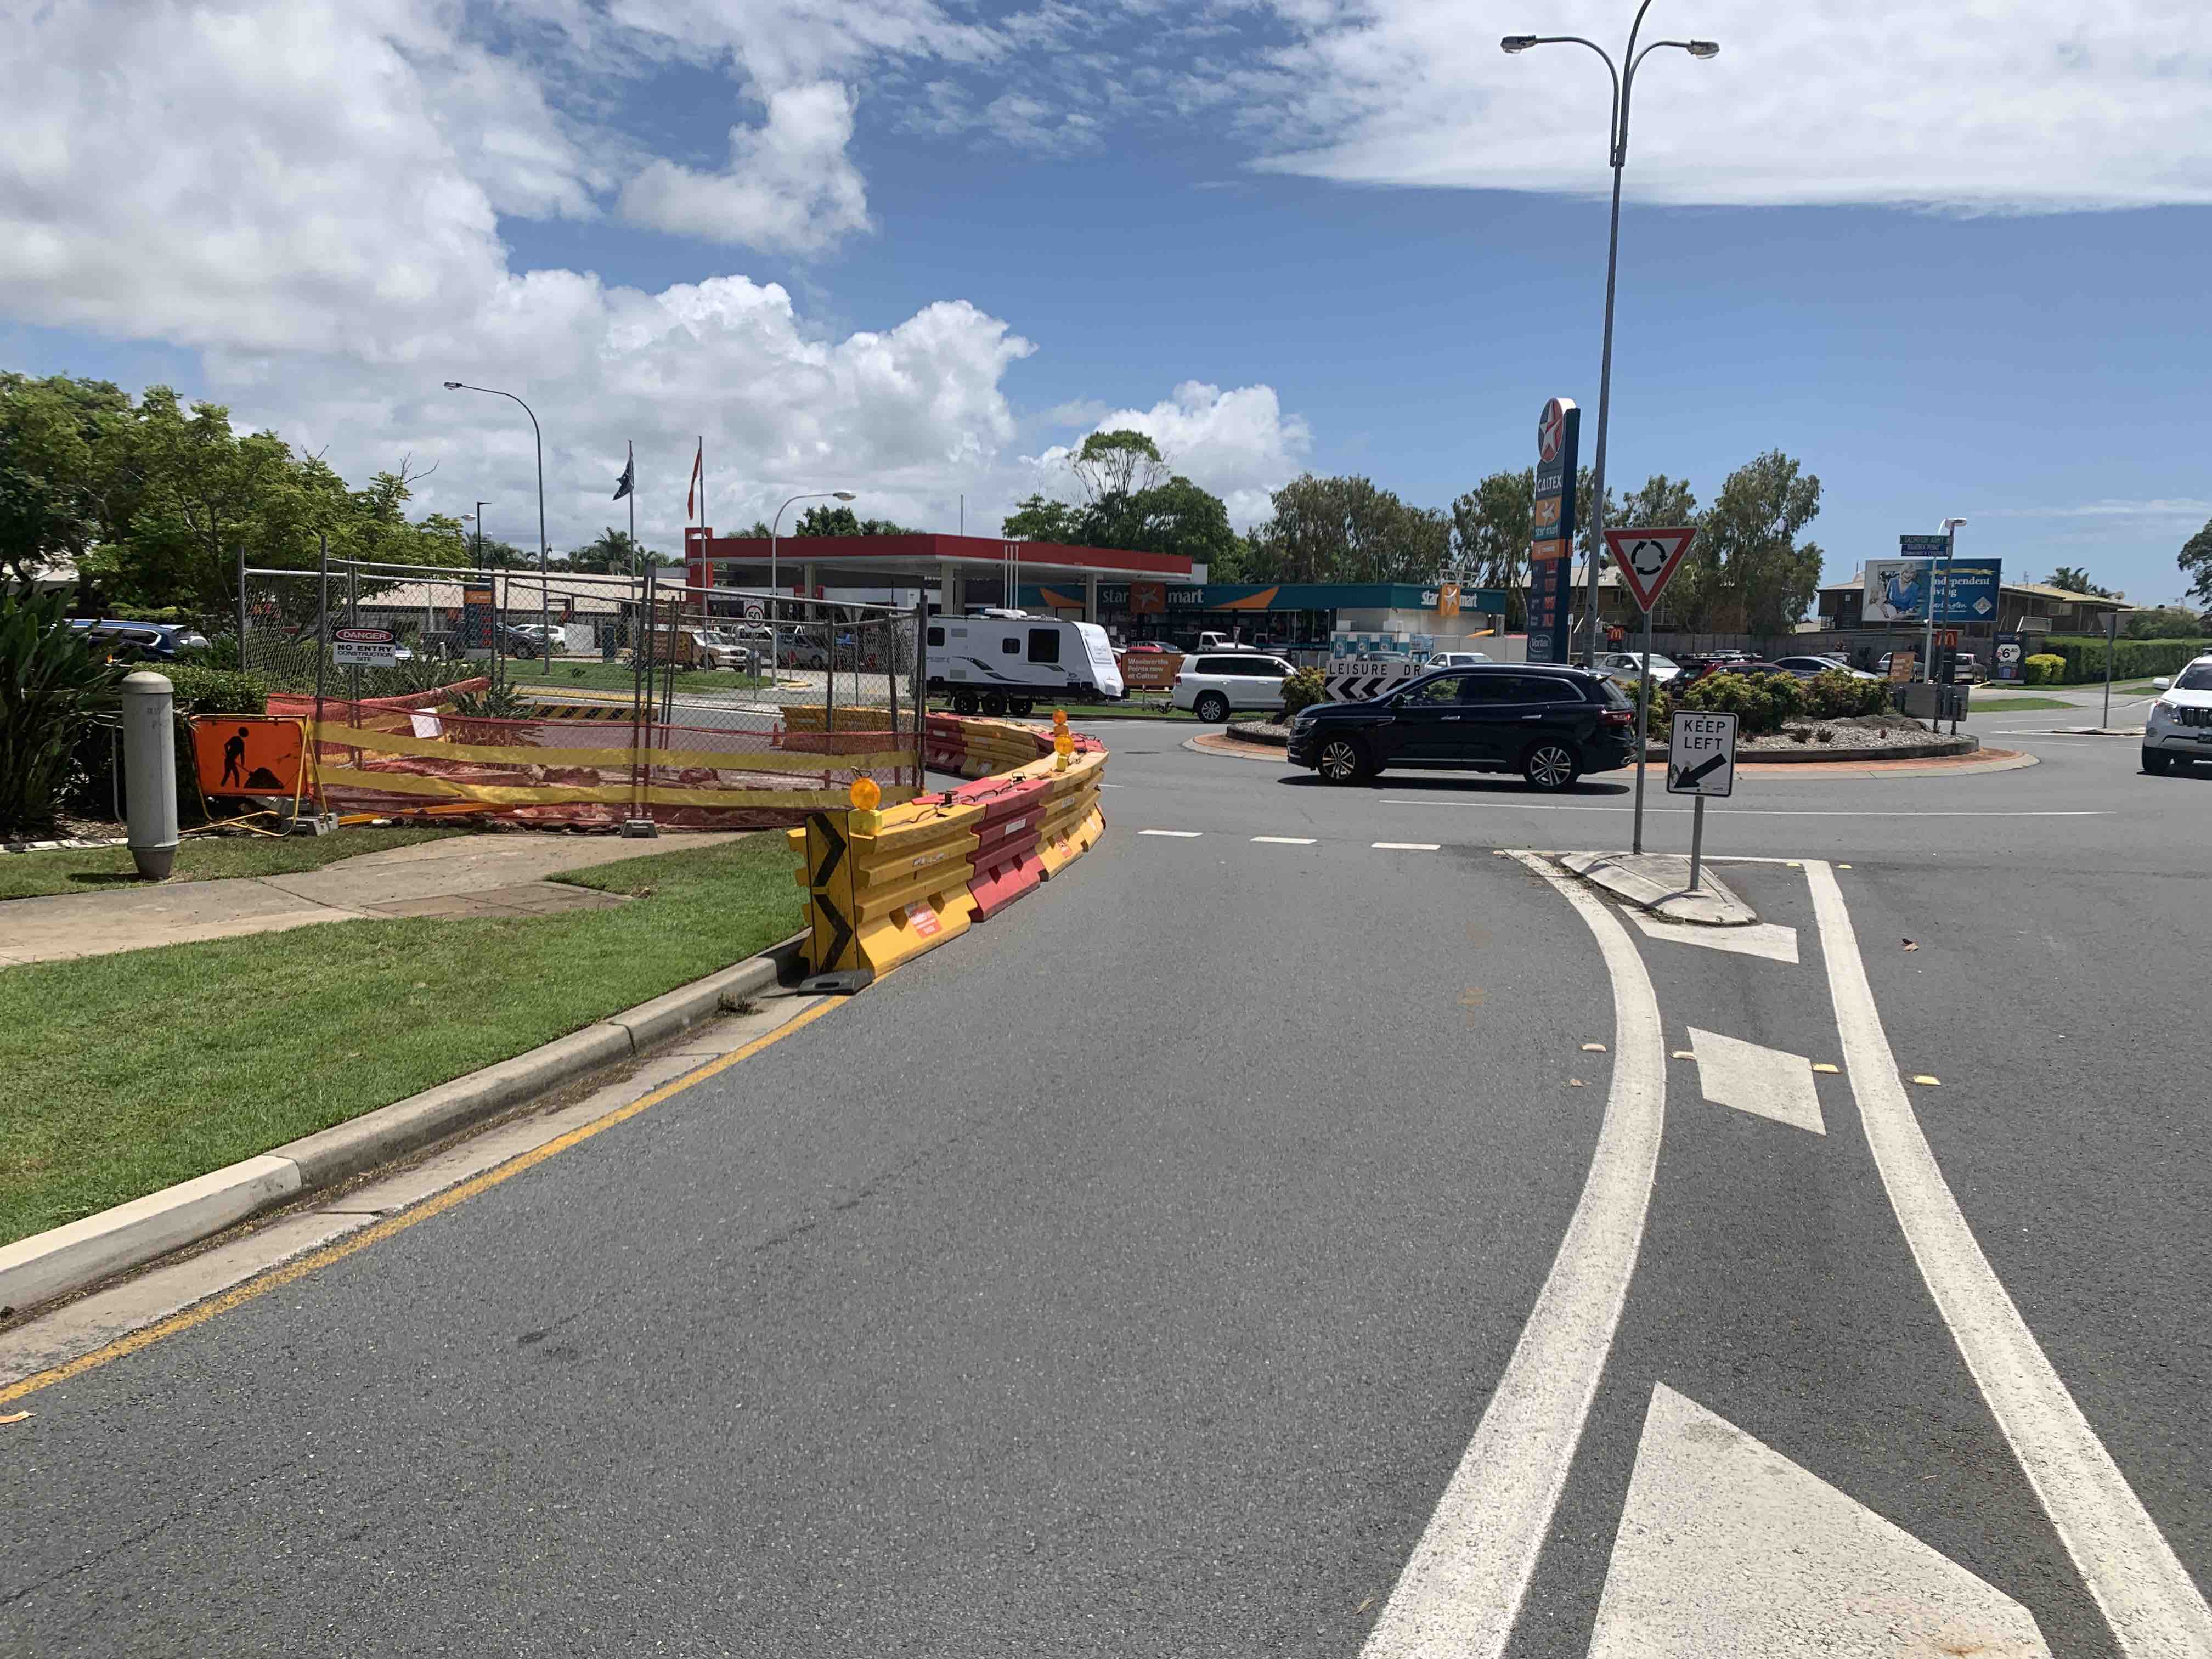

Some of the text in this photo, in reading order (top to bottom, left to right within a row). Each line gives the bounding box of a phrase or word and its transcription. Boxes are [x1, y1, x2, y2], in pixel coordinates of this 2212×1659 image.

[1537, 475, 1562, 492] CALTEX
[1102, 588, 1204, 603] star mart
[1421, 590, 1477, 607] star mart
[343, 631, 386, 640] DANGER
[1329, 664, 1421, 676] LEISURE DR
[1684, 720, 1725, 733] KEEP
[1684, 737, 1723, 751] LEFT
